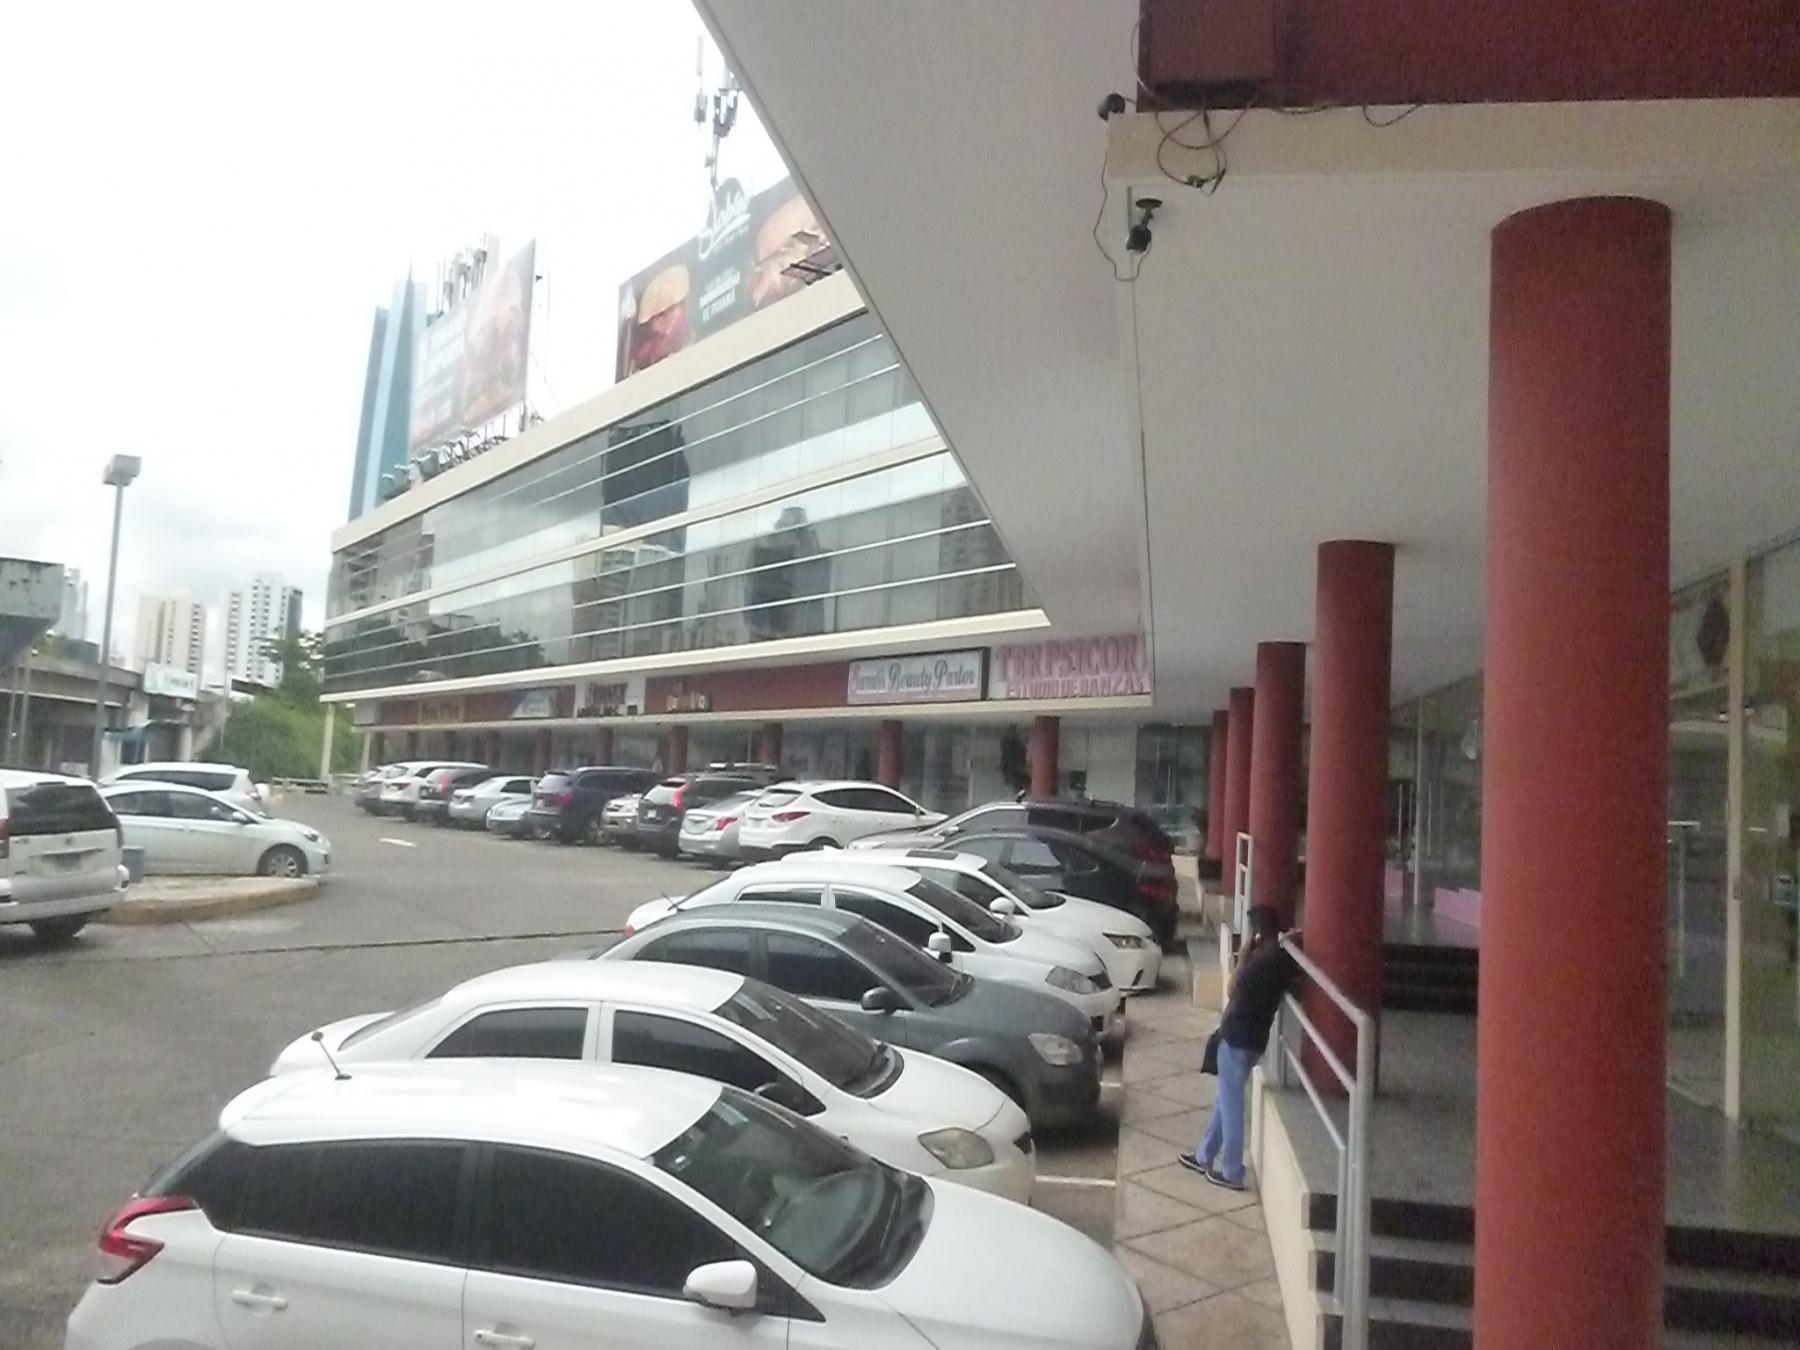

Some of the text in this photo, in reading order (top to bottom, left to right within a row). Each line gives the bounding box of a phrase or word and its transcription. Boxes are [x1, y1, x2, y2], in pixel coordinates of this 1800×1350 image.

[888, 660, 932, 695] Beauty
[933, 657, 975, 689] Parlor
[1079, 672, 1145, 697] DANZAS
